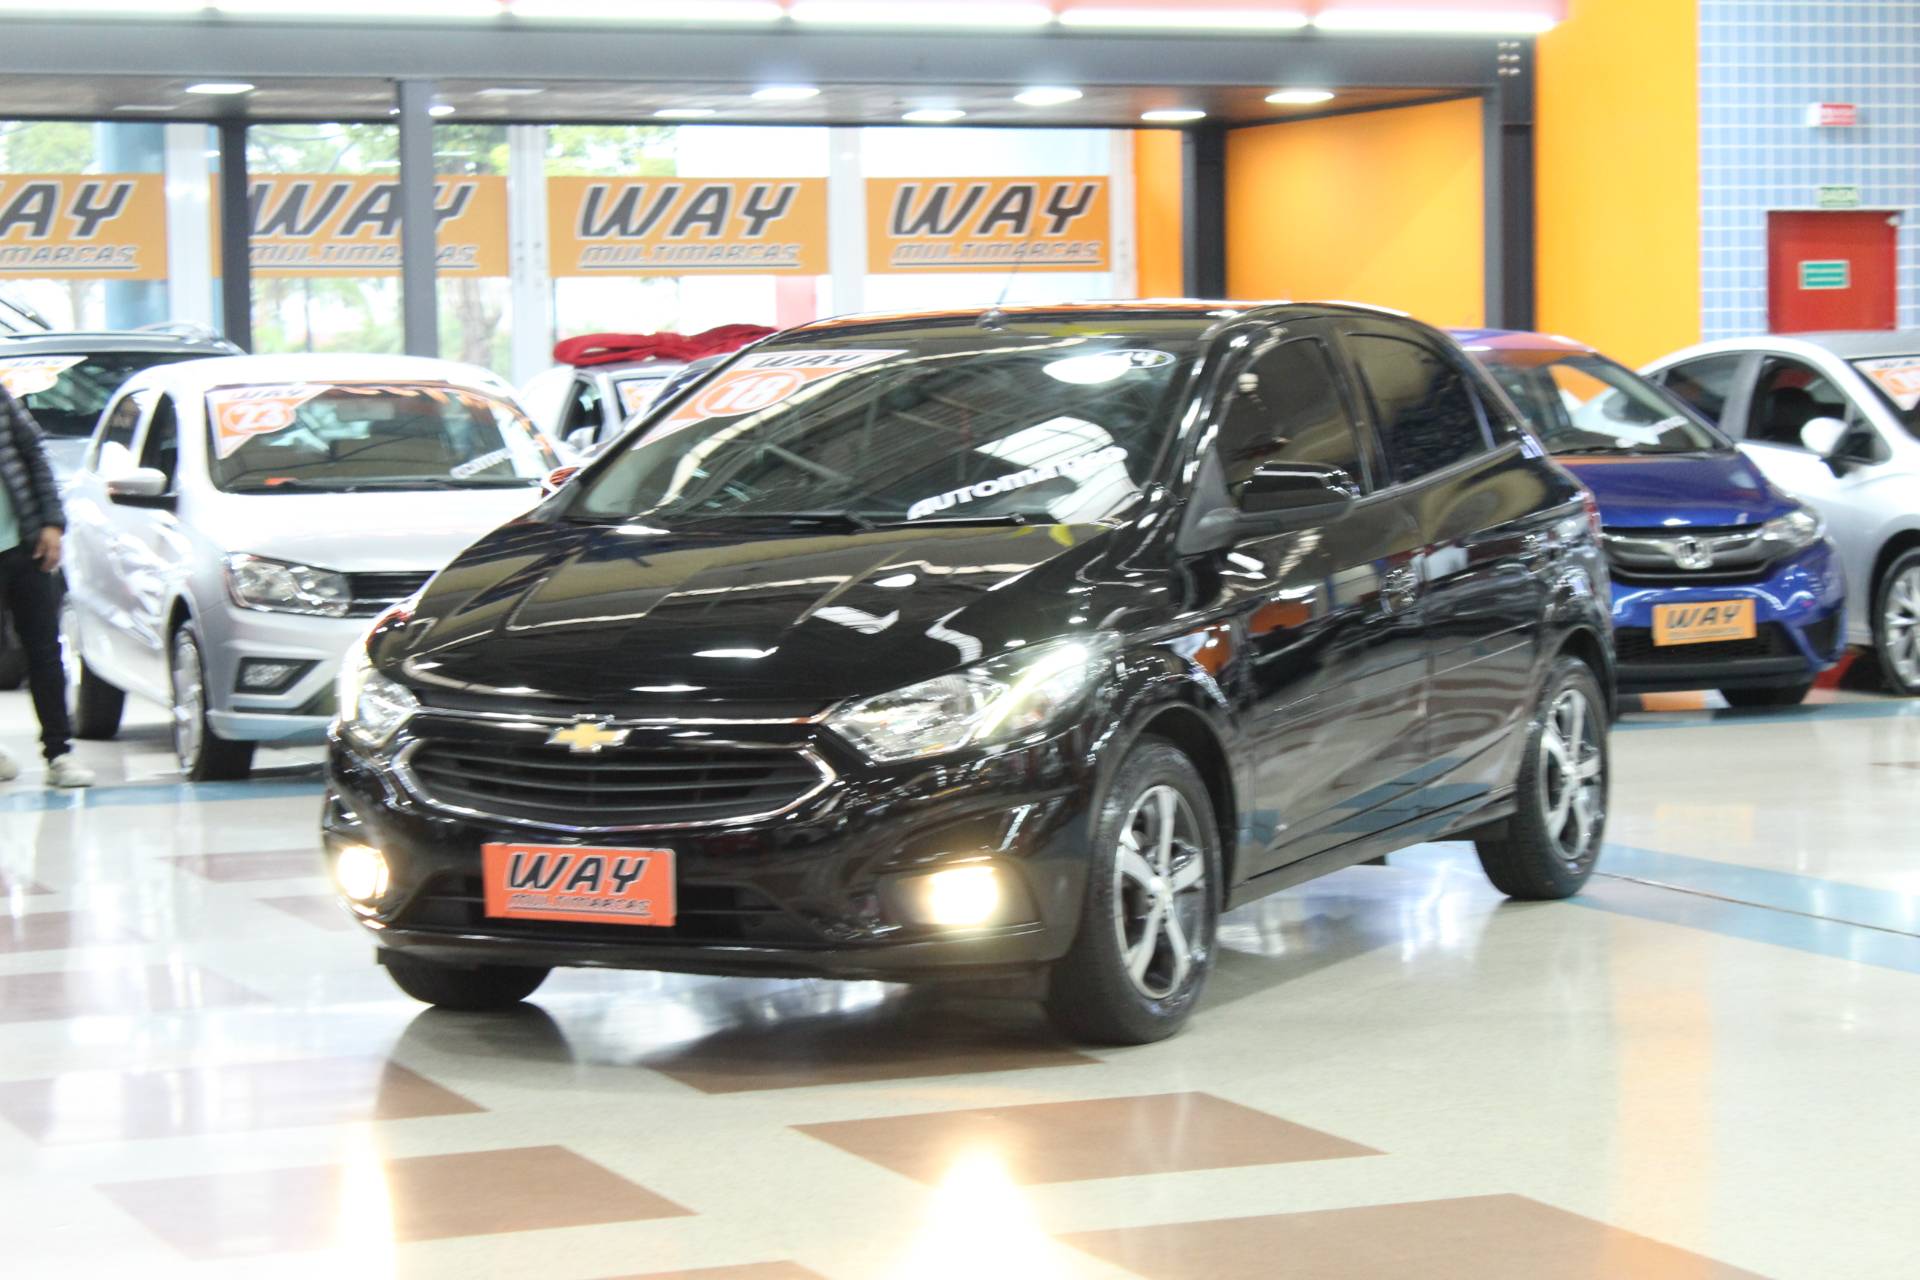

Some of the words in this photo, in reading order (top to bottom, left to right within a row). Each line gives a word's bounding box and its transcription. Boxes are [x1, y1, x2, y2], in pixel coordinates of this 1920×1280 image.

[0, 181, 137, 239] AY
[577, 184, 800, 239] WAY
[888, 183, 1101, 237] WAY
[581, 244, 800, 263] MULTIMARCAS
[892, 241, 1103, 260] MULTIMARCAS
[752, 354, 866, 368] WAY
[708, 375, 787, 410] 18
[1665, 604, 1743, 629] WAY
[505, 852, 651, 895] WAY
